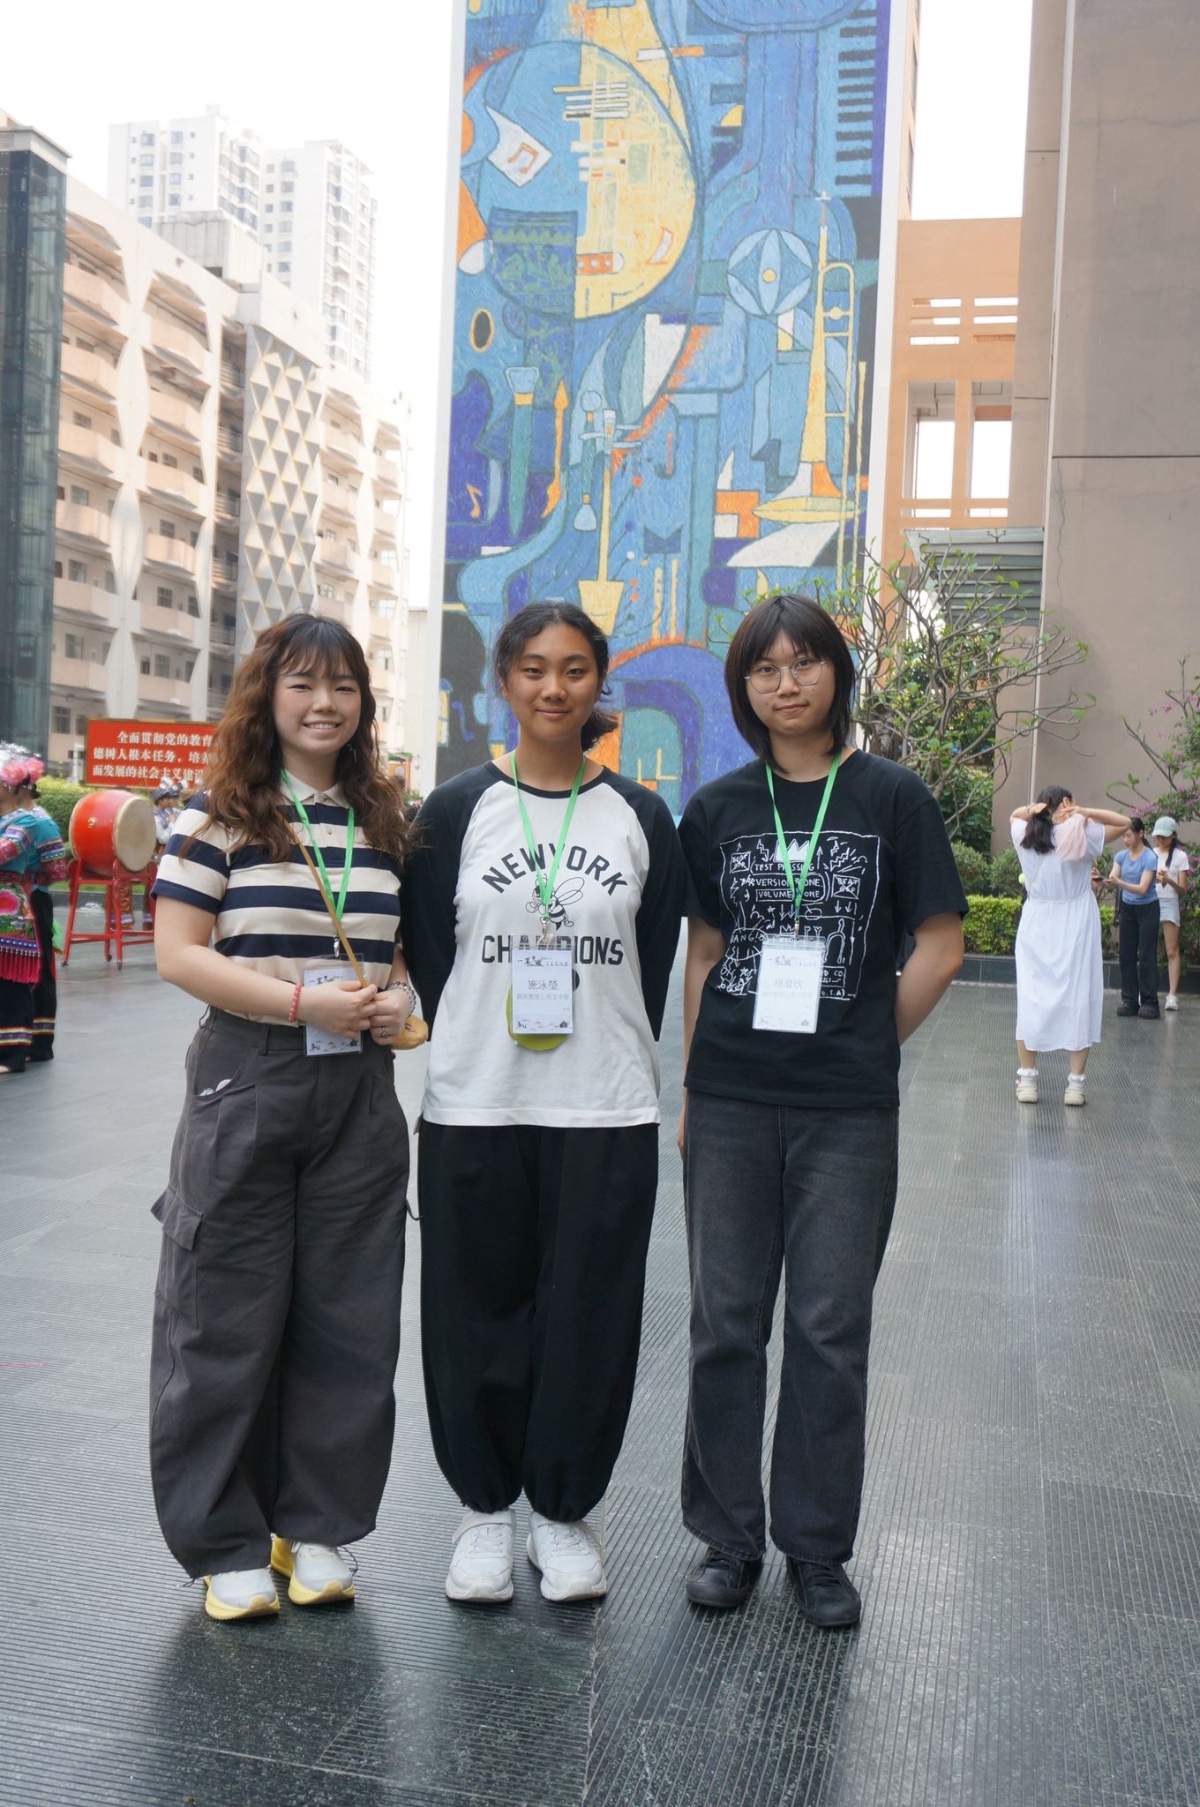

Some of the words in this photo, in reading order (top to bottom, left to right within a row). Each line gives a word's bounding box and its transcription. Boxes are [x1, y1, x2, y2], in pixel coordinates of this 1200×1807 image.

[117, 730, 213, 747] 全面贯彻党的教育
[481, 843, 546, 894] NEW
[754, 863, 774, 871] TEST
[777, 863, 815, 871] PSSIG
[756, 878, 792, 887] VERSIO
[758, 890, 792, 898] VOLUME
[804, 890, 820, 898] ONE
